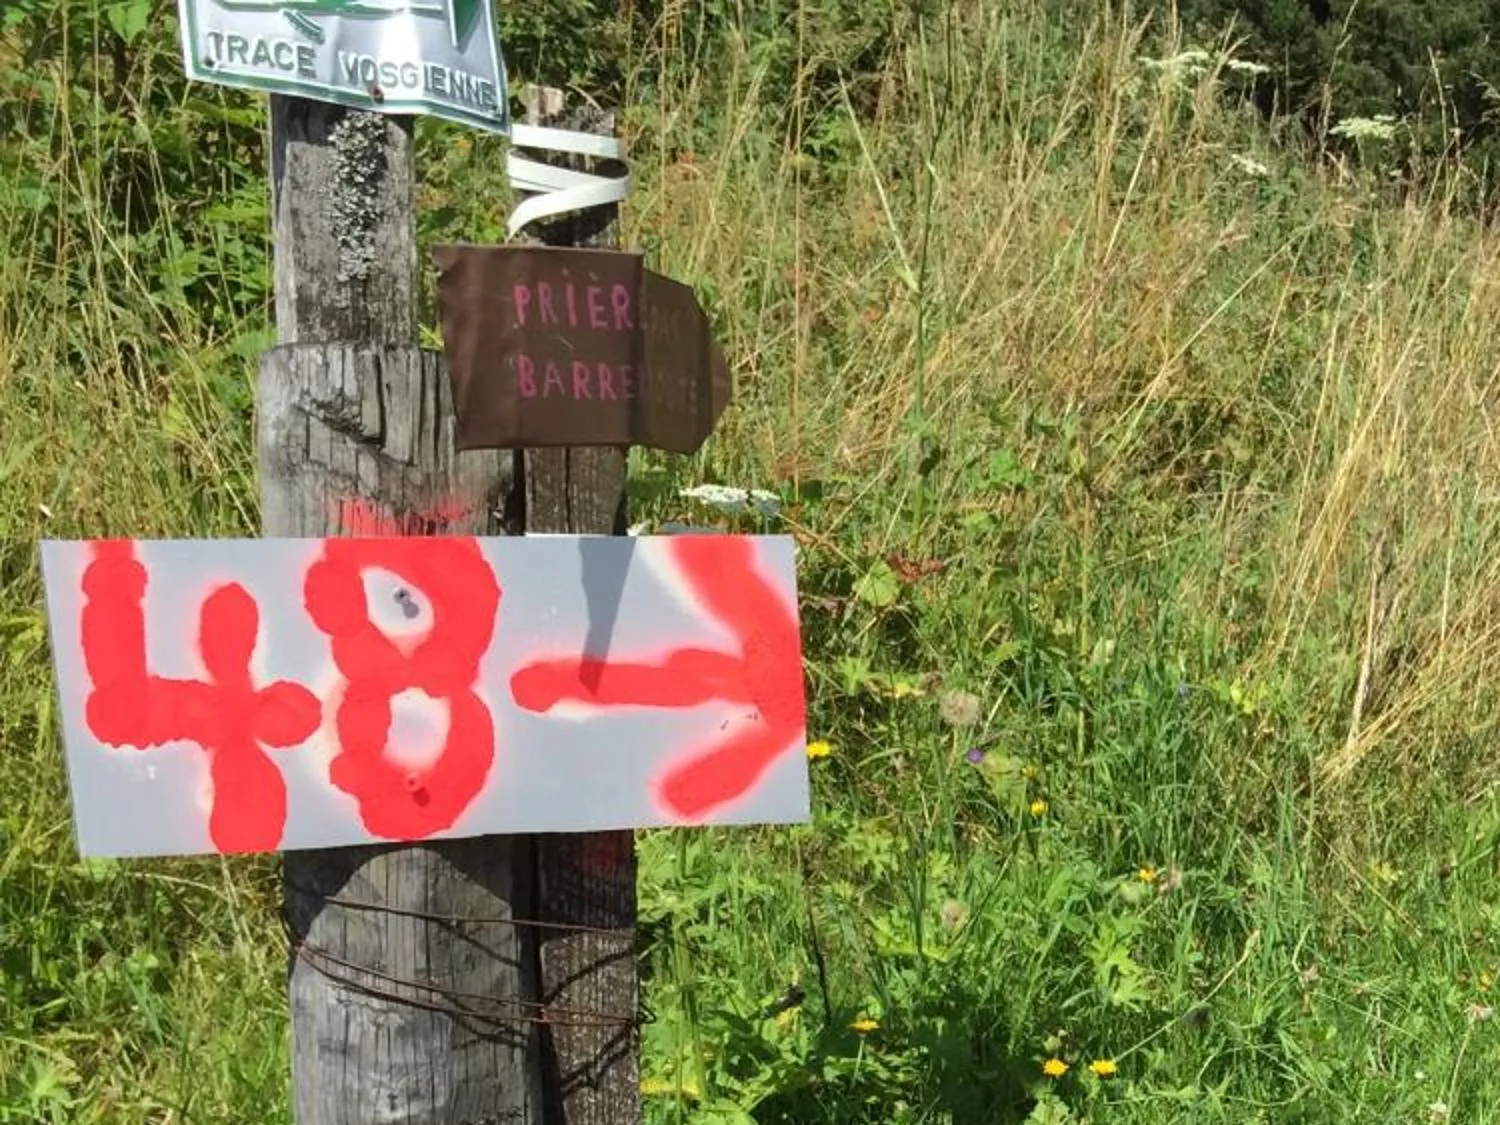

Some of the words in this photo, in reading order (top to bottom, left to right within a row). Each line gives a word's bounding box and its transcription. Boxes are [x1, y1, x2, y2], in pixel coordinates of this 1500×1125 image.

[206, 31, 317, 79] TRACE
[337, 50, 499, 115] VOSGIENNE
[80, 537, 503, 855] 48
